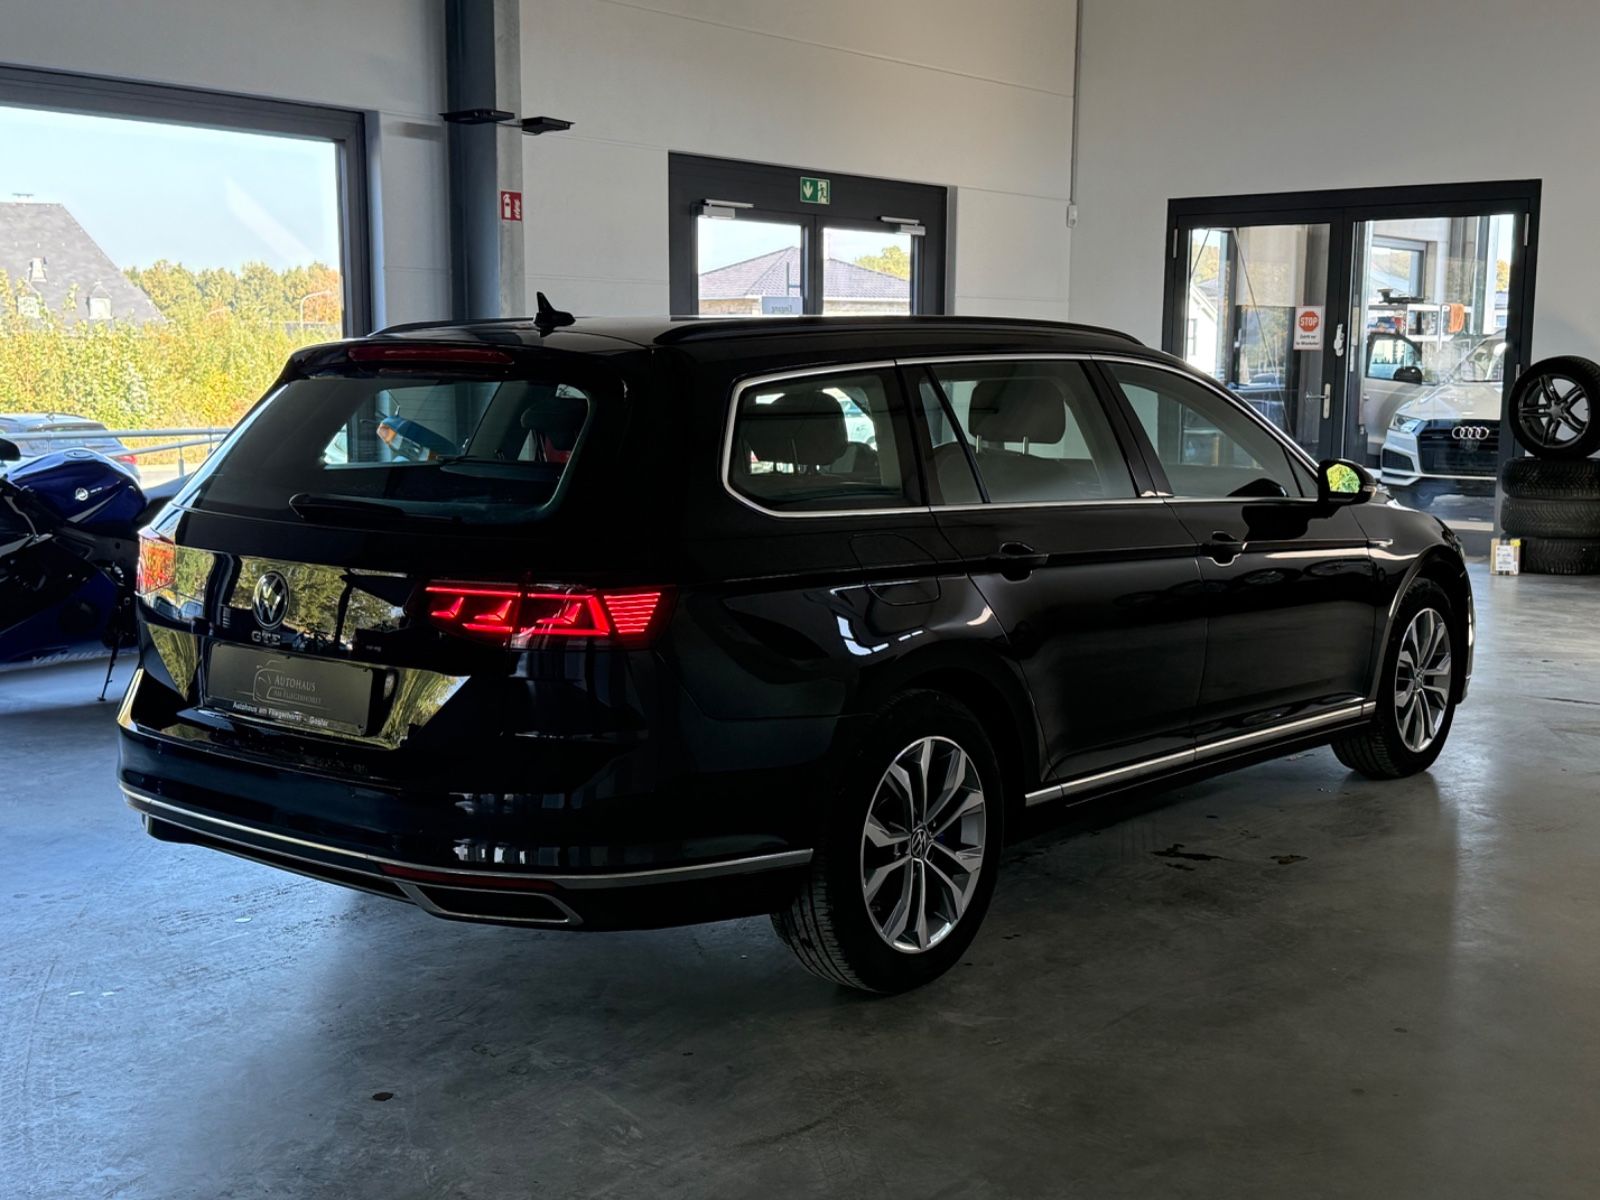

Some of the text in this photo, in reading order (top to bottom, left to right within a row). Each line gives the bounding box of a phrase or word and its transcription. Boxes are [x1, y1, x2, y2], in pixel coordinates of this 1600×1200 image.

[1300, 316, 1318, 327] STOP
[251, 630, 281, 645] GTE
[274, 675, 316, 692] AUTOHAUS
[232, 701, 258, 713] Autohaus
[268, 708, 302, 722] Fliegerhorst
